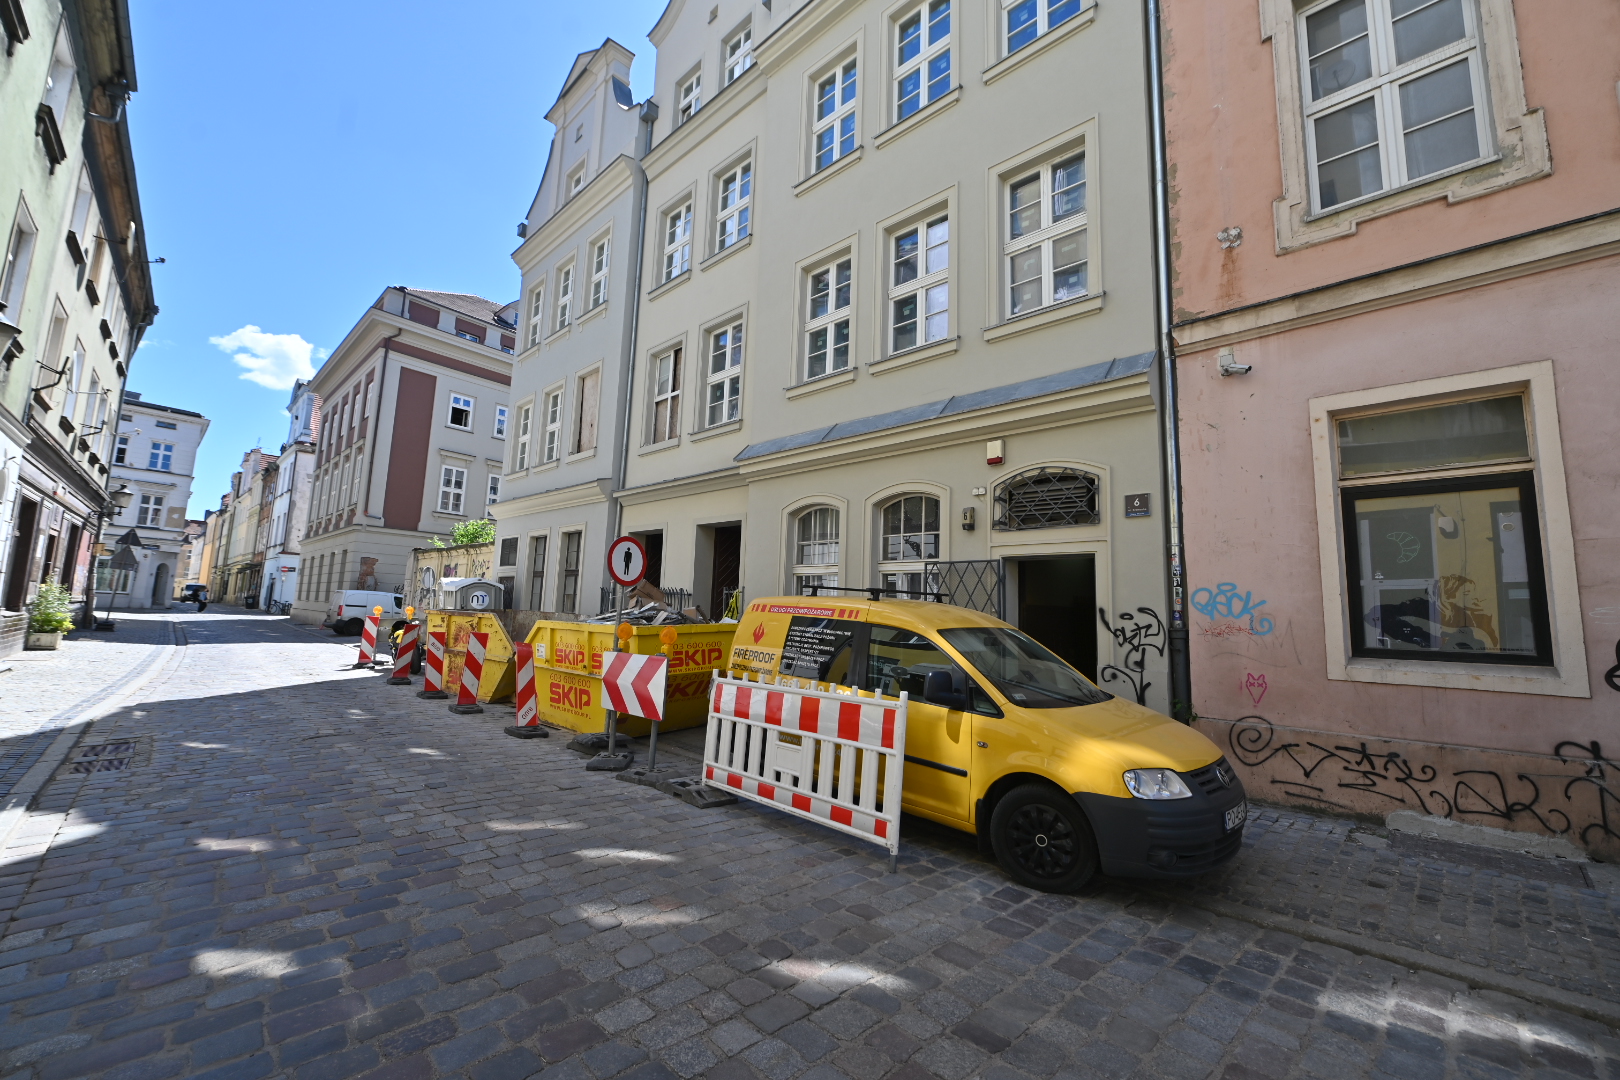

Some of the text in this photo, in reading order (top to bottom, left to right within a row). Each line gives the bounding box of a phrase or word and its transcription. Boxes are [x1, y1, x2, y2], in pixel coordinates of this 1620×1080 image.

[1133, 497, 1140, 507] 6
[963, 511, 968, 521] 6
[687, 641, 704, 649] 600
[555, 648, 585, 667] SKIP
[669, 648, 723, 669] SKIP
[732, 648, 777, 665] FIREPROOF
[550, 681, 592, 710] SKIP
